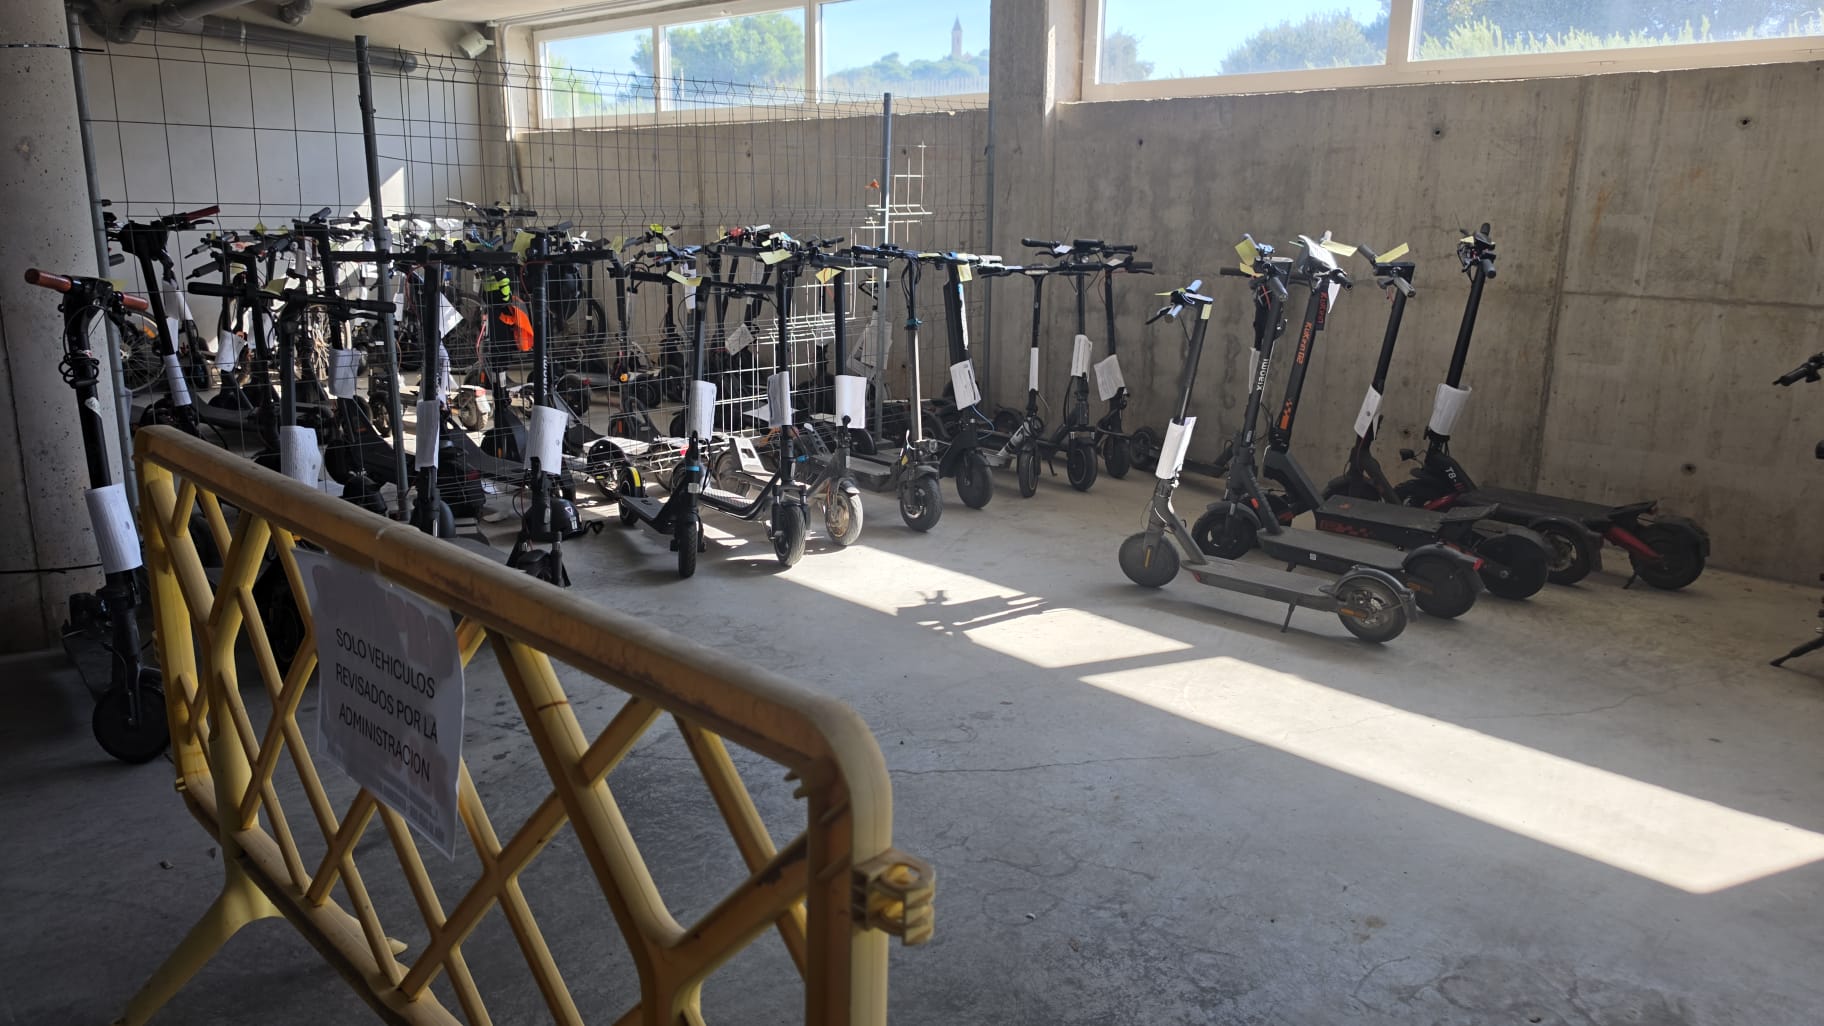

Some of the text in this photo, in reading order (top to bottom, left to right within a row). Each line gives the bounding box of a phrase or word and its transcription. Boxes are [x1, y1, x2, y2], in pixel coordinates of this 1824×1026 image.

[335, 627, 436, 699] SOLO VEHICULOS
[335, 662, 438, 745] REVISADOS POR LA
[338, 702, 430, 783] ADMINISTRACION
